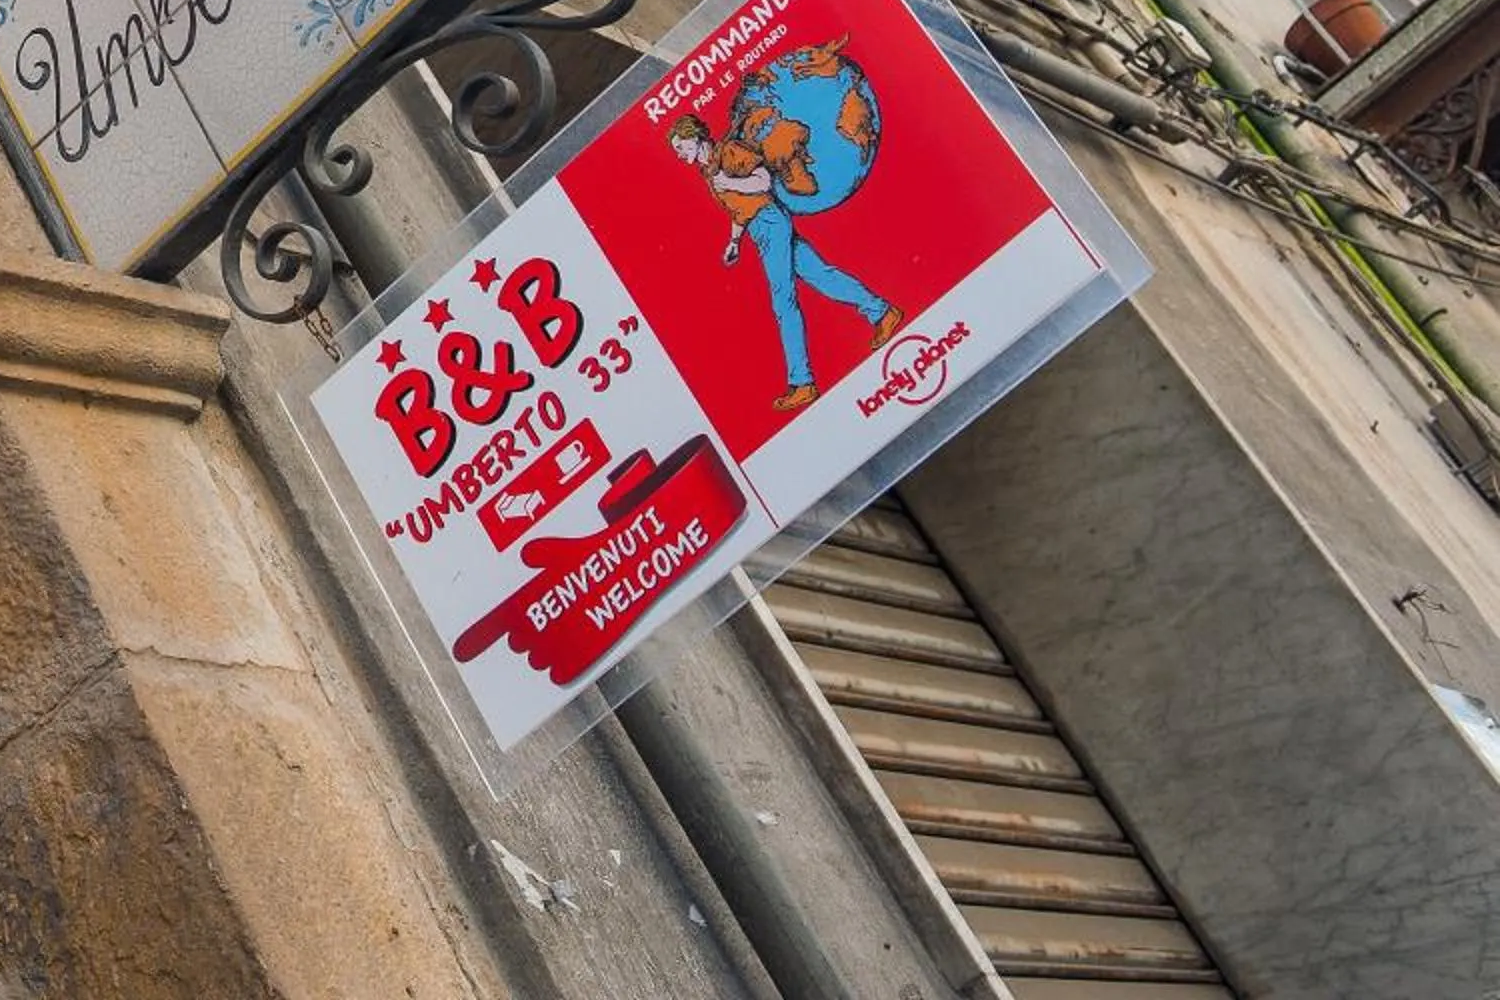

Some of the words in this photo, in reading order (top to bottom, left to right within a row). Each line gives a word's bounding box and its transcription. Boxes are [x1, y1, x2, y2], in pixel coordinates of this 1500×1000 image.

[692, 87, 717, 112] PAR
[719, 71, 735, 88] LE
[737, 24, 787, 71] ROUTARD
[375, 257, 583, 477] B&B
[857, 368, 916, 417] lonely
[914, 322, 970, 379] planet
[526, 506, 665, 632] BENVENUTI
[585, 518, 710, 630] WELCOME
